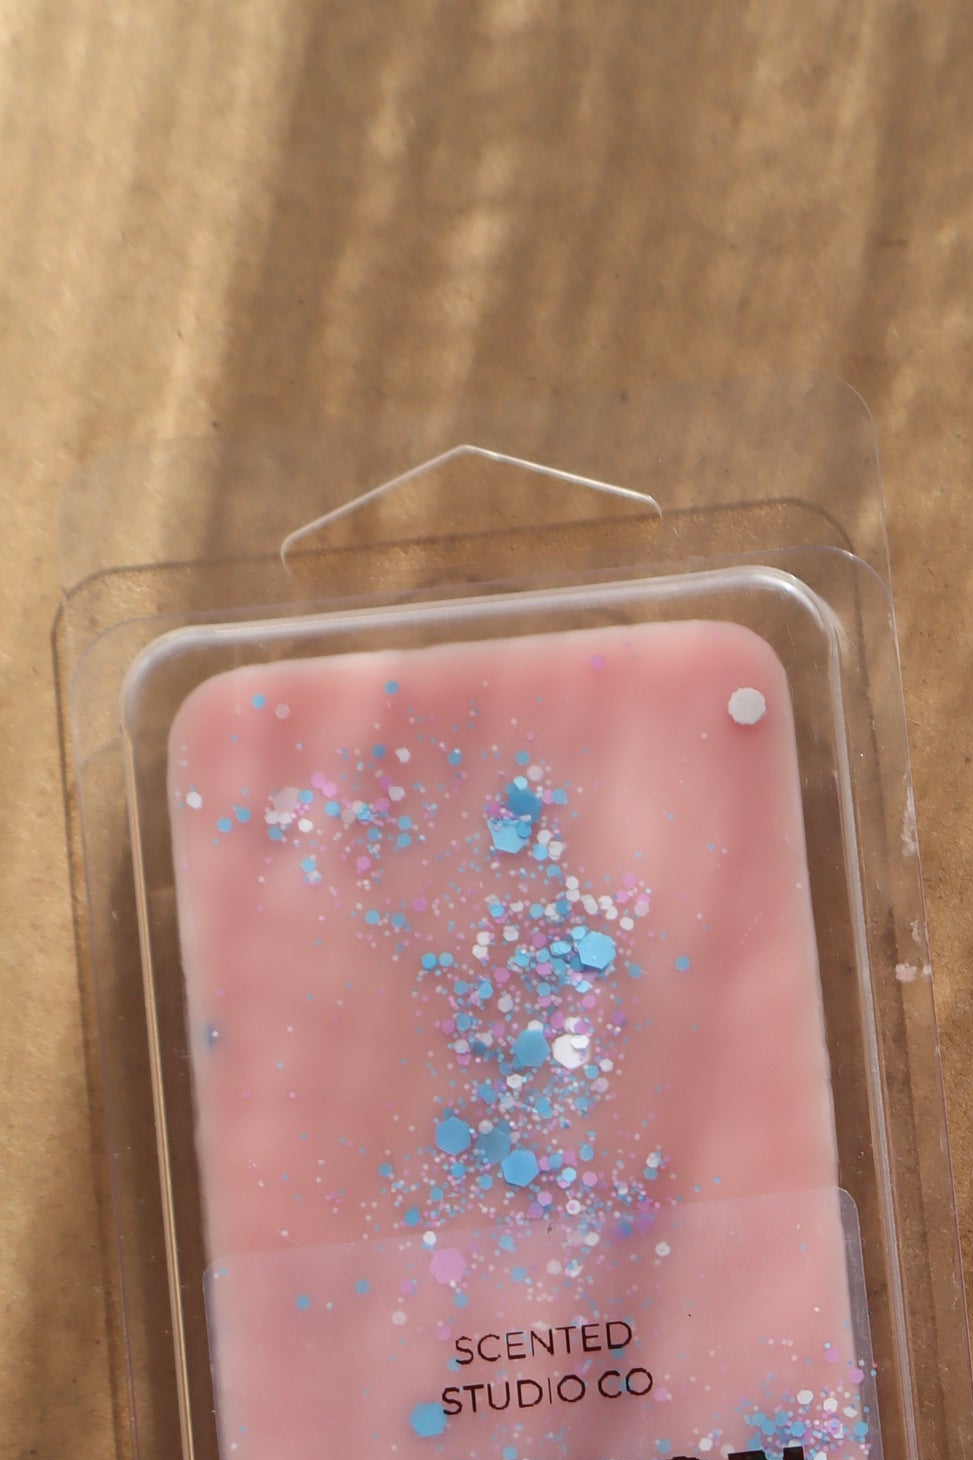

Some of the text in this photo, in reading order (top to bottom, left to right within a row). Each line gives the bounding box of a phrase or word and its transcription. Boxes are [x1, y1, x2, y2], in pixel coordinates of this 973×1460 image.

[454, 1321, 633, 1365] SCENTED
[441, 1367, 653, 1415] STUDIO CO
